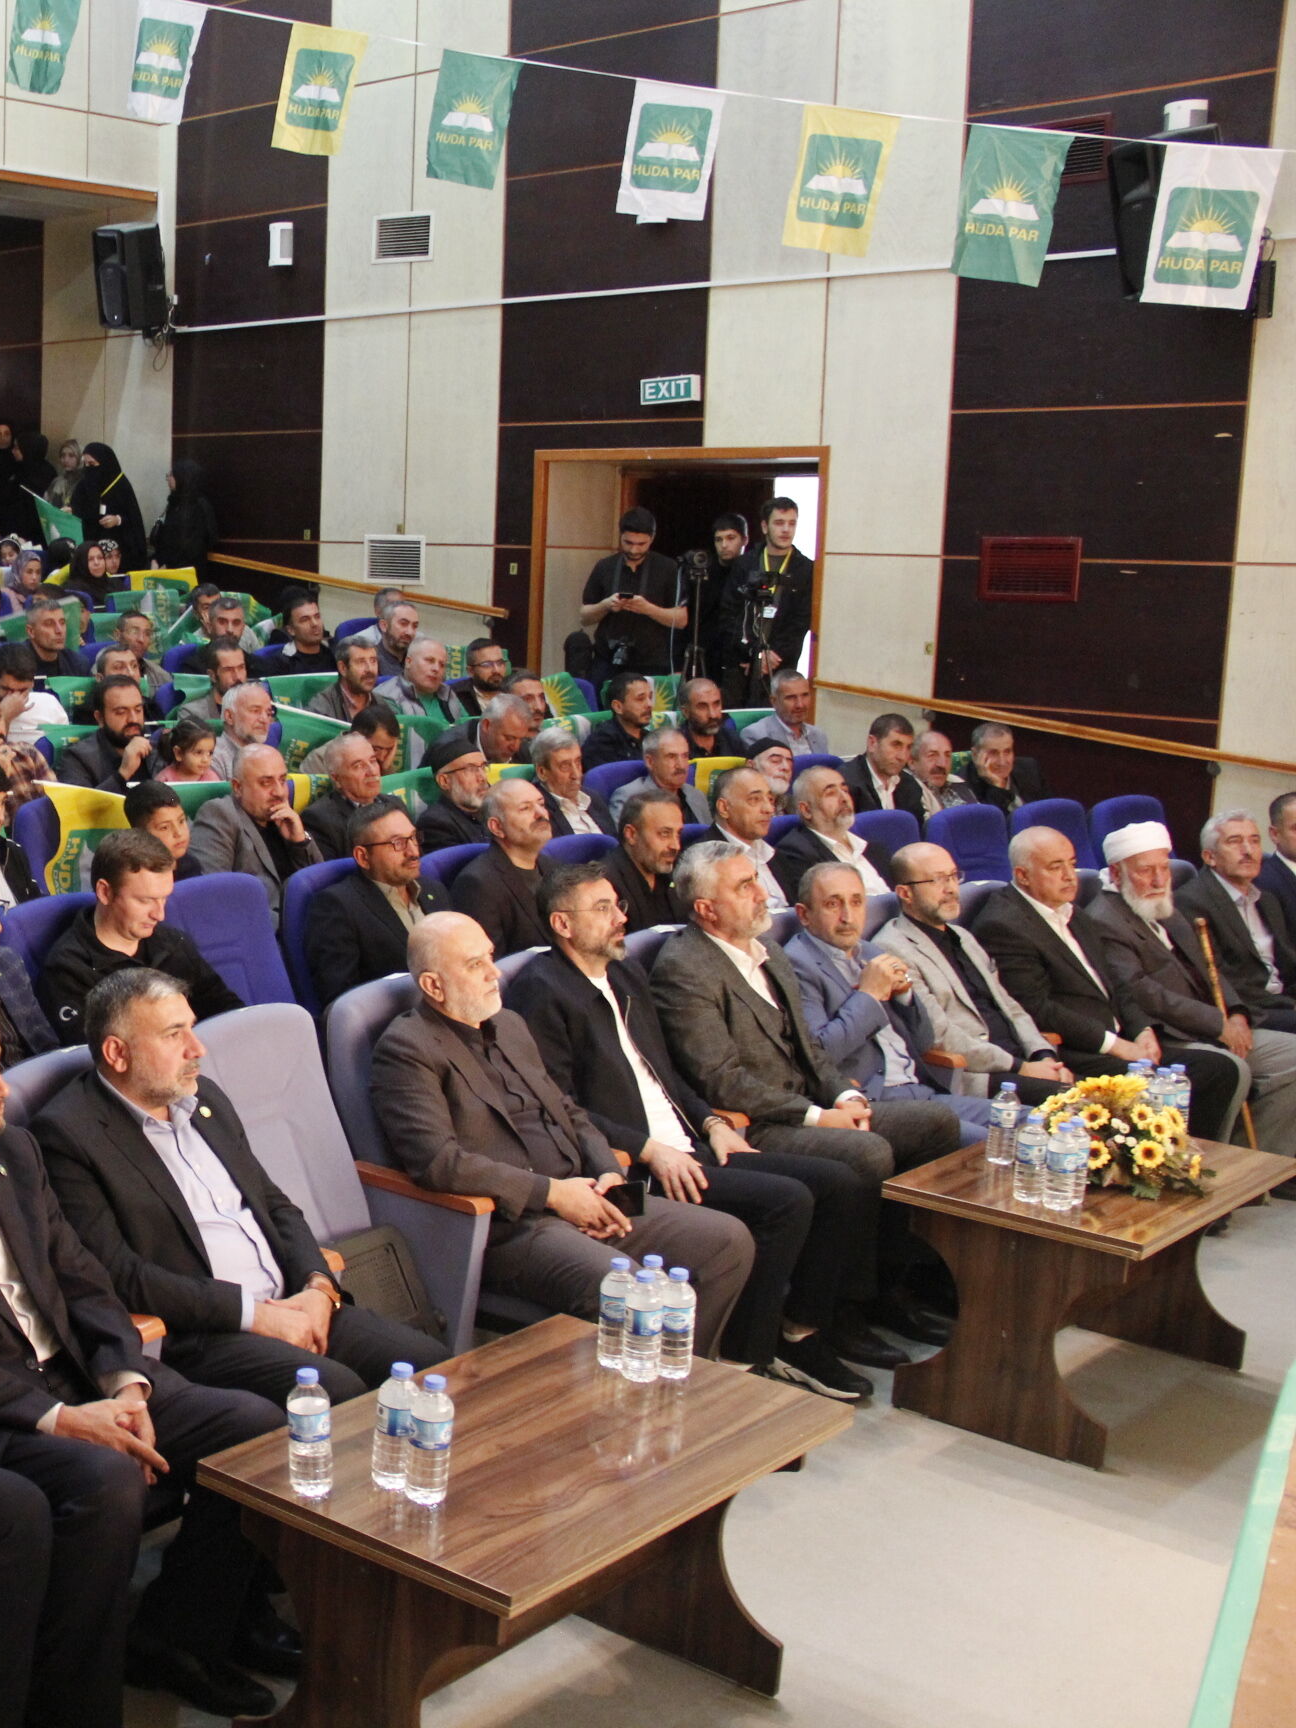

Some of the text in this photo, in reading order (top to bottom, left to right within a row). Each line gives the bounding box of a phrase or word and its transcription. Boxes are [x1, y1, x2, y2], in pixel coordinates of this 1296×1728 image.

[672, 168, 701, 181] PAR
[1008, 226, 1039, 242] PAR
[1209, 259, 1242, 275] PAR
[645, 380, 688, 399] EXIT
[451, 646, 462, 680] HUD
